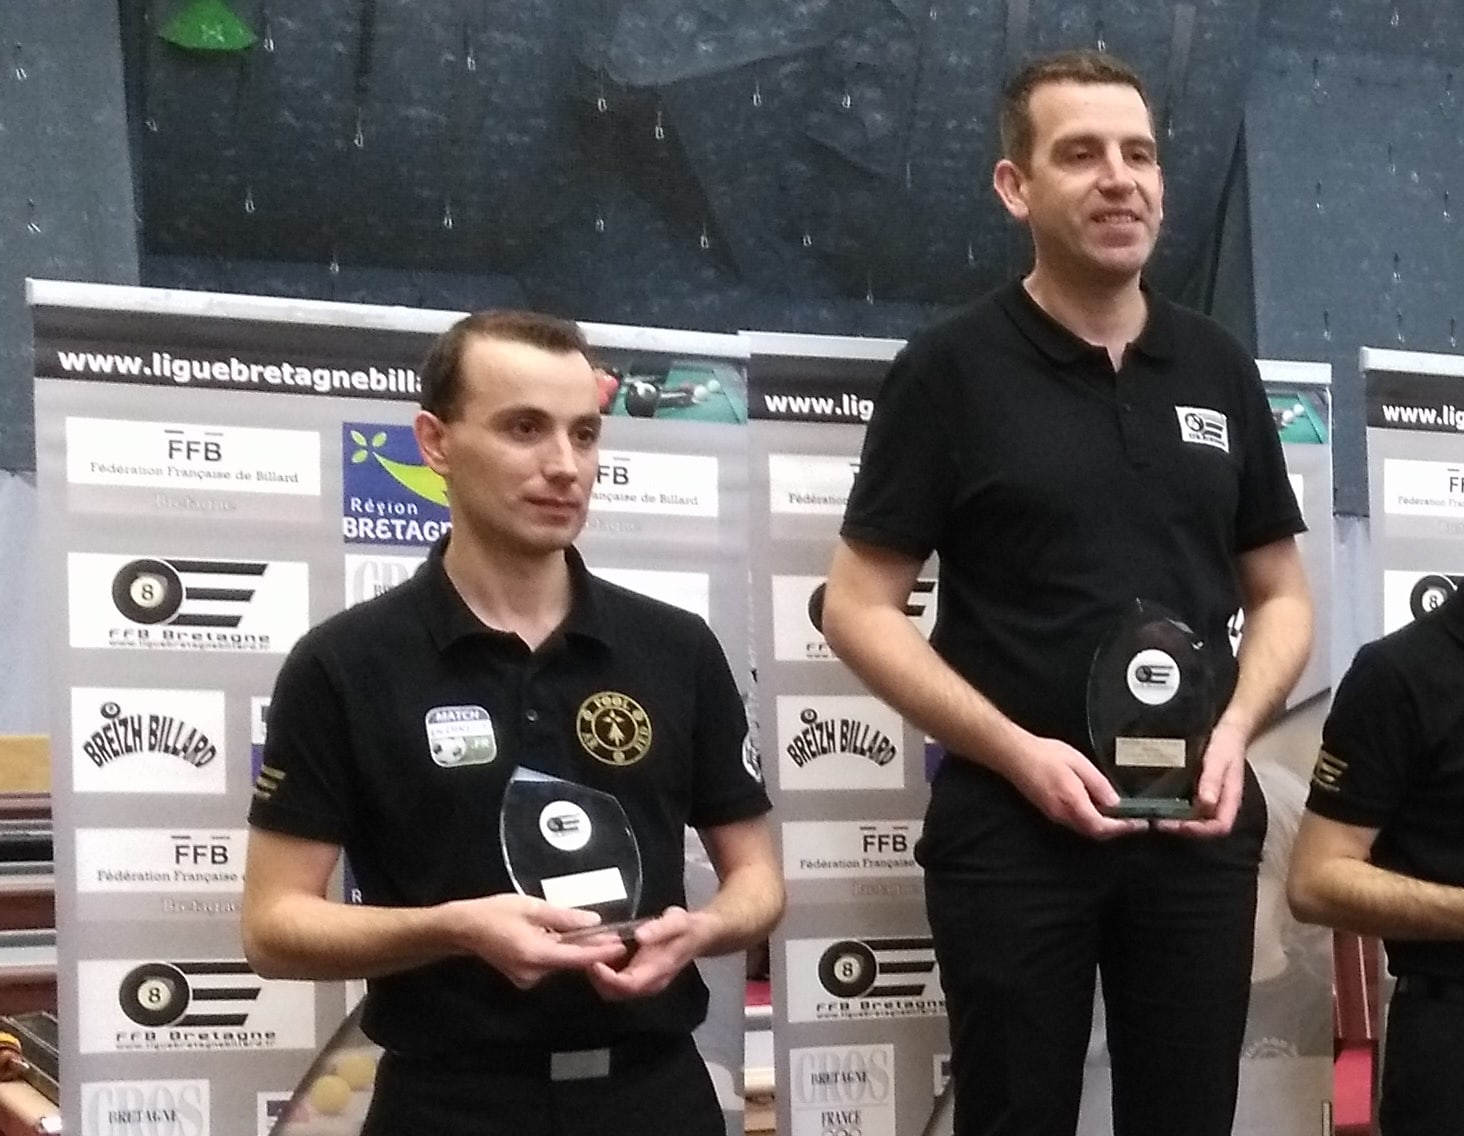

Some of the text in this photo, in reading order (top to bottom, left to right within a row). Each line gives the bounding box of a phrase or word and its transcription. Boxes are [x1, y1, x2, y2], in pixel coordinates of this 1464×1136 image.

[168, 439, 222, 462] FFB
[167, 466, 231, 480] Française
[235, 469, 251, 481] de
[256, 471, 299, 484] Billard
[597, 464, 629, 486] FB
[350, 497, 418, 515] Région
[162, 629, 270, 644] Bretagne
[83, 714, 216, 768] BREIZH BILLARD
[786, 719, 896, 768] BREIZH BILLARD
[863, 834, 908, 853] FFB
[175, 845, 228, 865] FFB
[800, 860, 860, 869] Fédération
[97, 869, 238, 885] Fédération Française
[169, 1031, 276, 1042] Bretagne
[821, 1109, 862, 1128] FRANCE
